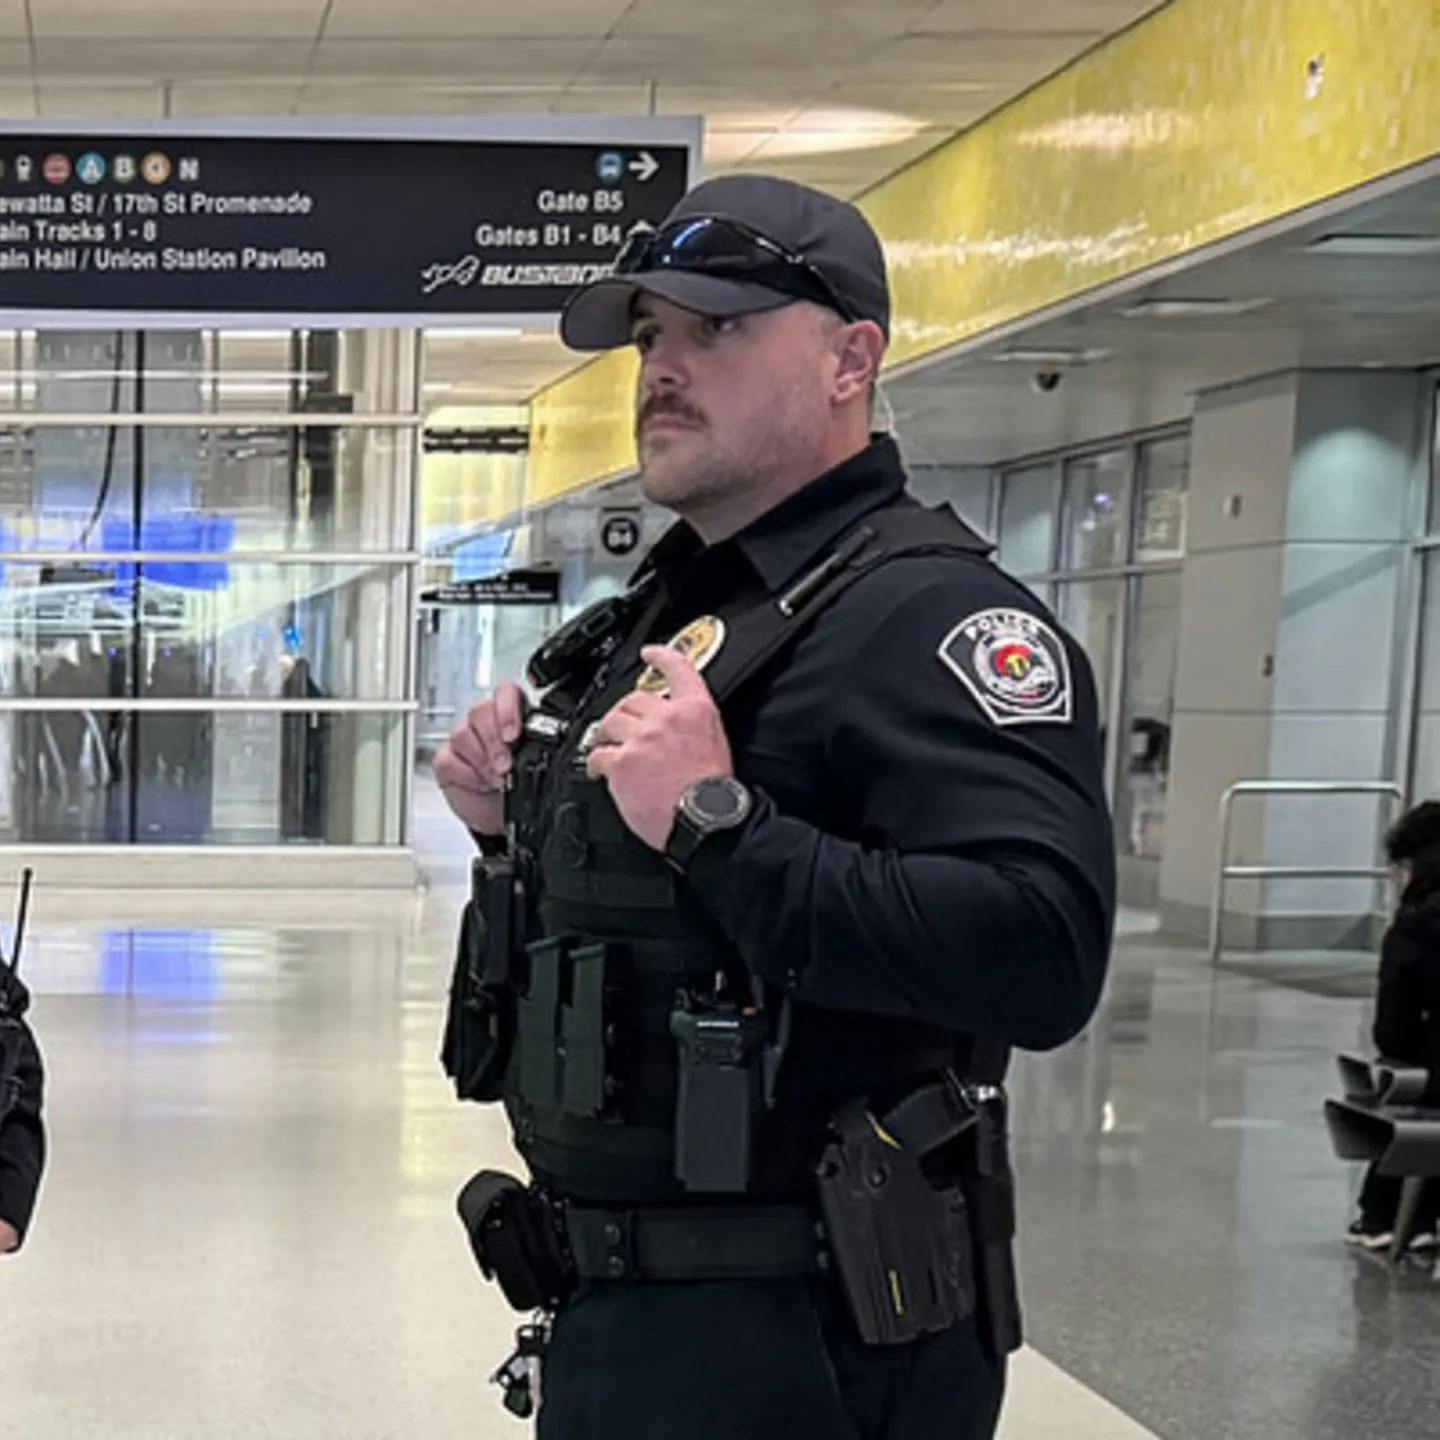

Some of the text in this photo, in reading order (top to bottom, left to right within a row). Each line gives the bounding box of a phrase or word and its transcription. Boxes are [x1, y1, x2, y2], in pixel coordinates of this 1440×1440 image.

[71, 192, 94, 213] St
[113, 193, 159, 213] 17th
[163, 191, 186, 213] St
[191, 191, 312, 213] Promenade
[538, 190, 624, 212] Gate B5
[35, 220, 105, 241] Tracks
[112, 220, 122, 241] 1
[143, 220, 157, 241] 8
[475, 224, 538, 246] Gates
[544, 224, 571, 246] B1
[593, 224, 621, 246] B4
[35, 248, 77, 270] Hall
[95, 248, 157, 270] Union
[162, 248, 237, 270] Station
[242, 248, 326, 270] Pavilion
[964, 613, 1039, 641] POLICE
